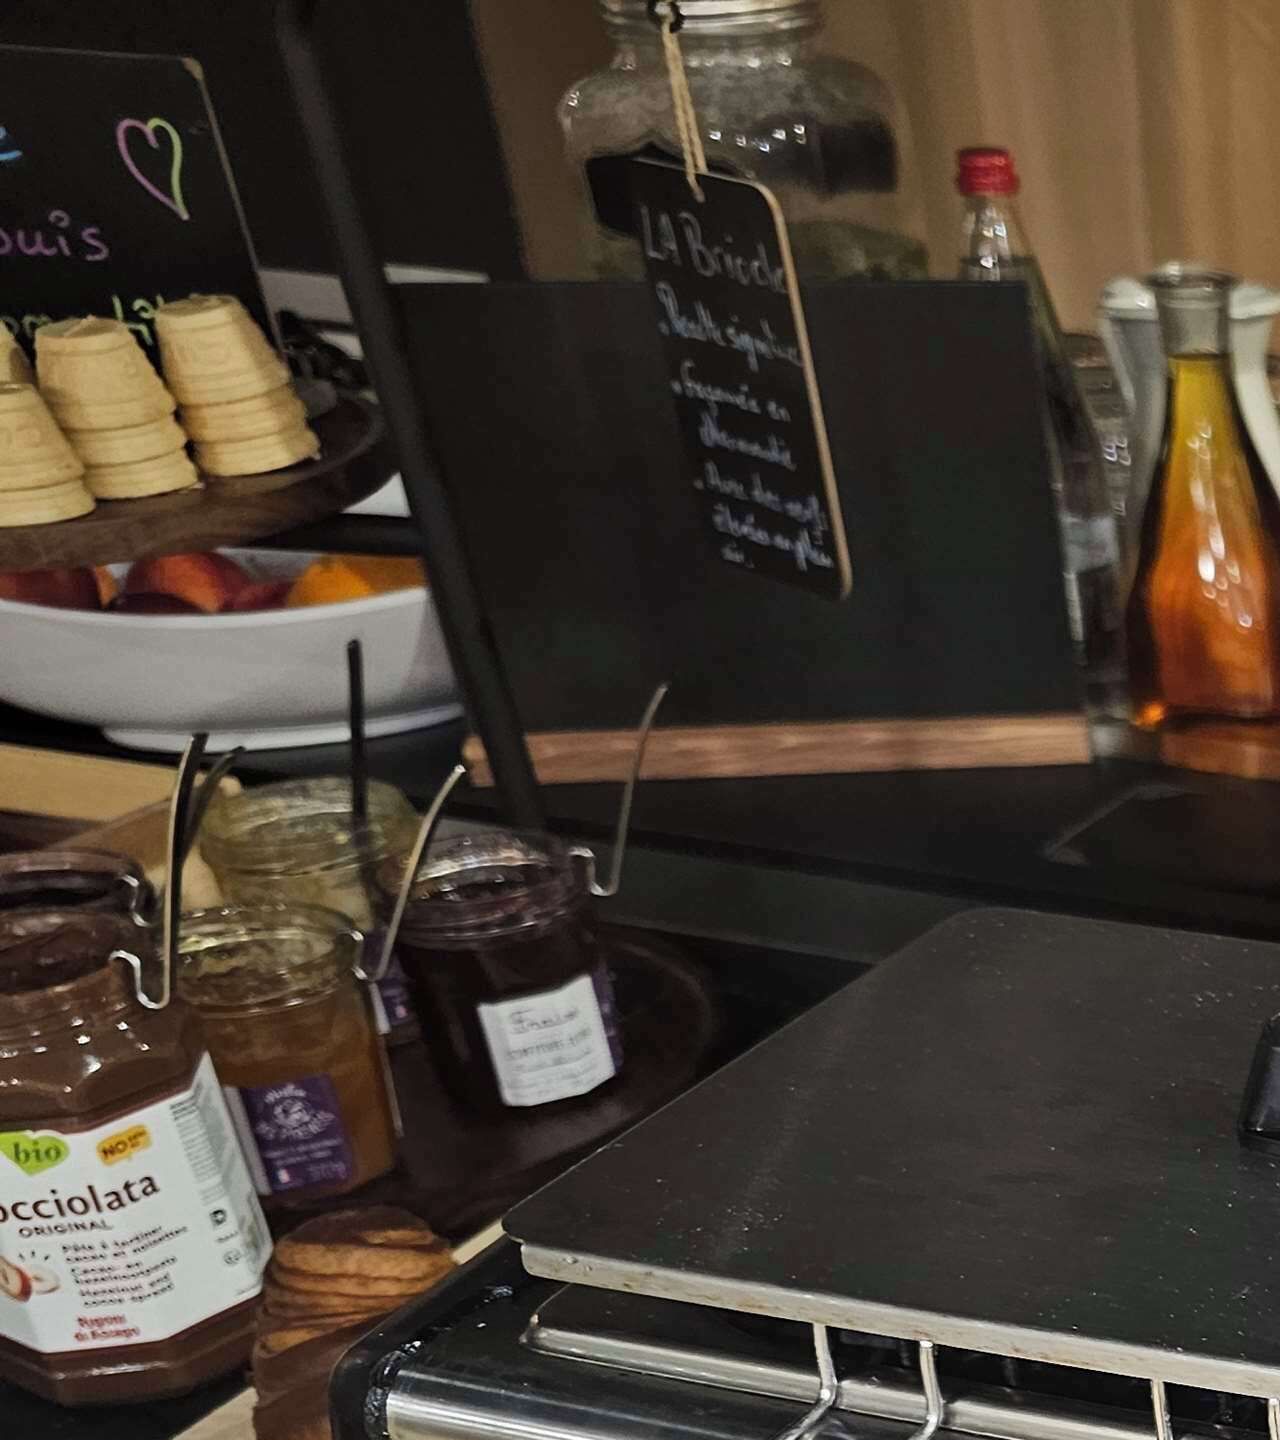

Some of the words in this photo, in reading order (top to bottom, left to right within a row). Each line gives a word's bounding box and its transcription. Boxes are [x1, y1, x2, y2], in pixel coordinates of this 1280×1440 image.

[12, 1142, 62, 1164] bio
[101, 1139, 128, 1160] NO
[18, 1217, 114, 1238] ORIGINAL
